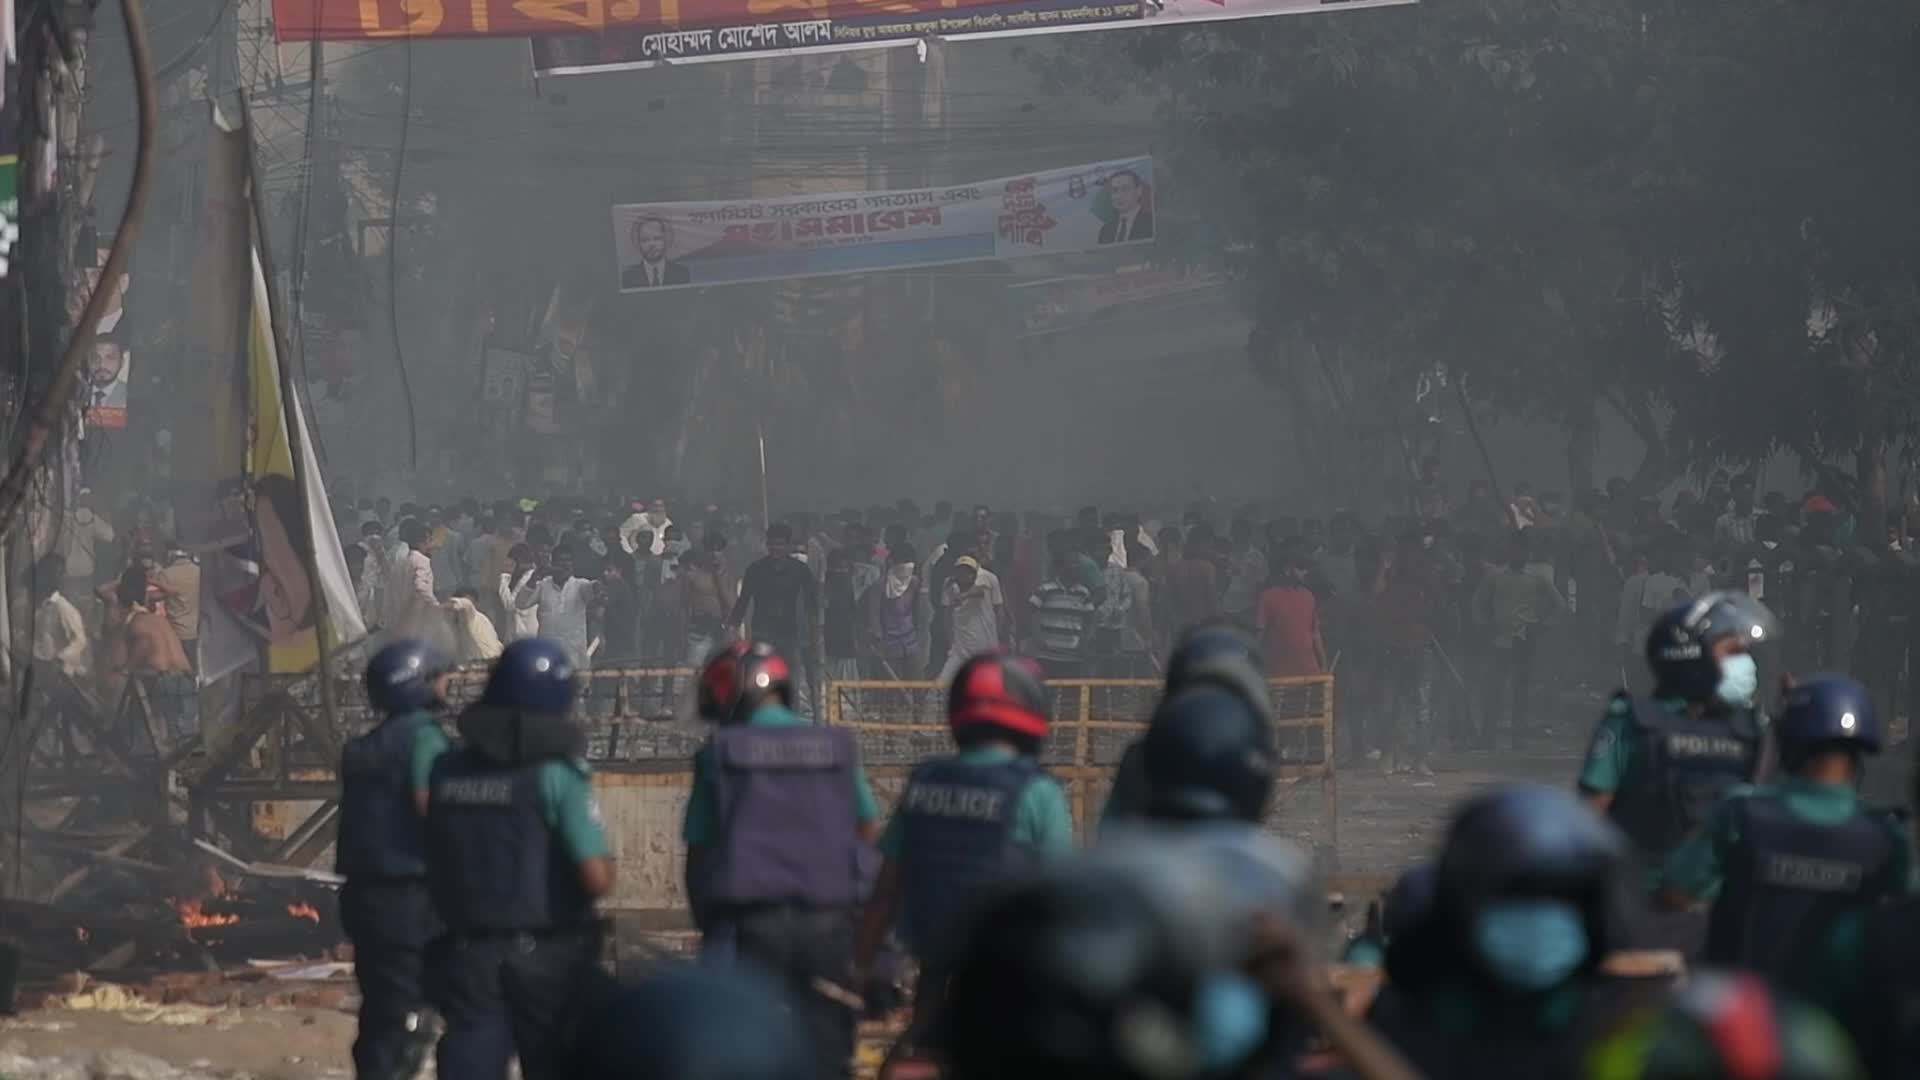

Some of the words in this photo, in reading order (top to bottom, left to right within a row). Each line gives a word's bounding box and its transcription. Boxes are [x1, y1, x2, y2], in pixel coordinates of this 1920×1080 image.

[641, 30, 713, 56] মোহাম্মদ
[783, 19, 832, 43] আলম
[940, 186, 984, 201] এবং
[720, 207, 942, 241] মহাসমাবেশ
[907, 785, 1007, 820] POLICE
